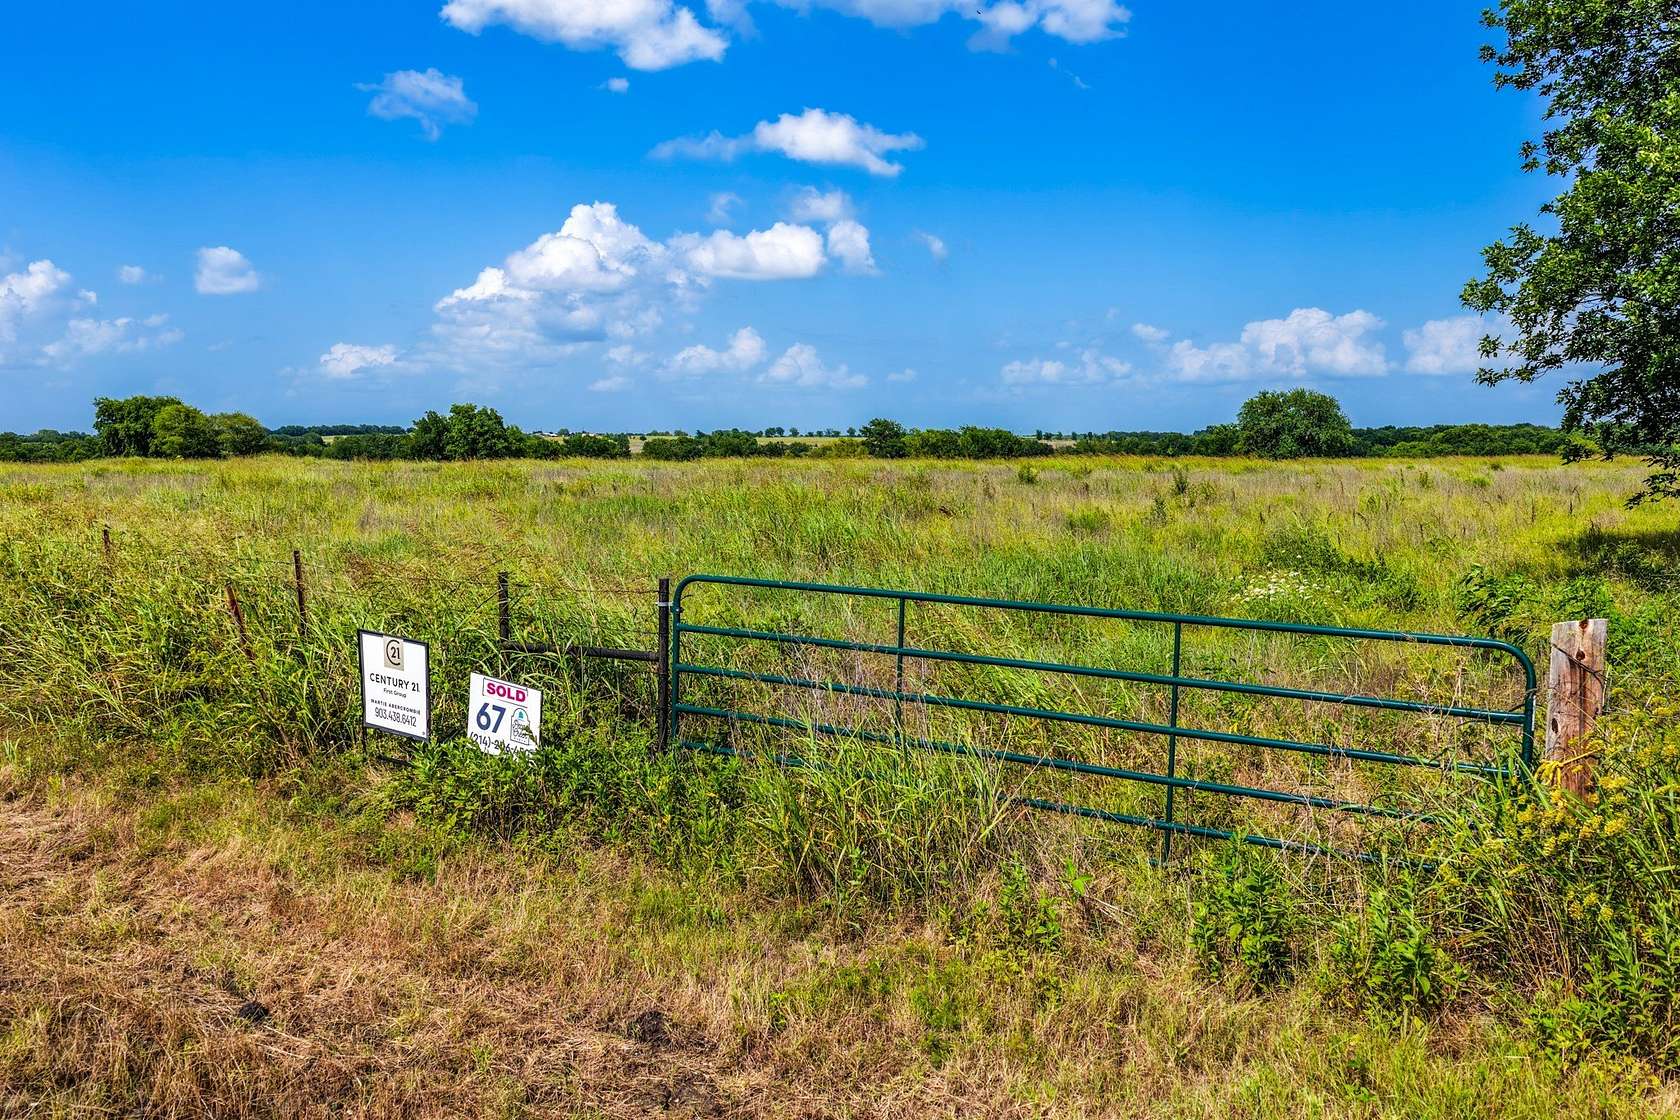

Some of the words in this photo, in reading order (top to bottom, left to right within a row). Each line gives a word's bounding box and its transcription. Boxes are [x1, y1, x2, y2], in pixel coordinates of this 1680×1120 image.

[369, 672, 410, 690] CENTURY
[411, 682, 420, 692] 21
[486, 682, 526, 702] SOLD
[383, 687, 393, 695] First
[394, 690, 407, 698] Group
[374, 706, 417, 728] 903.438.6412
[476, 702, 507, 734] 67
